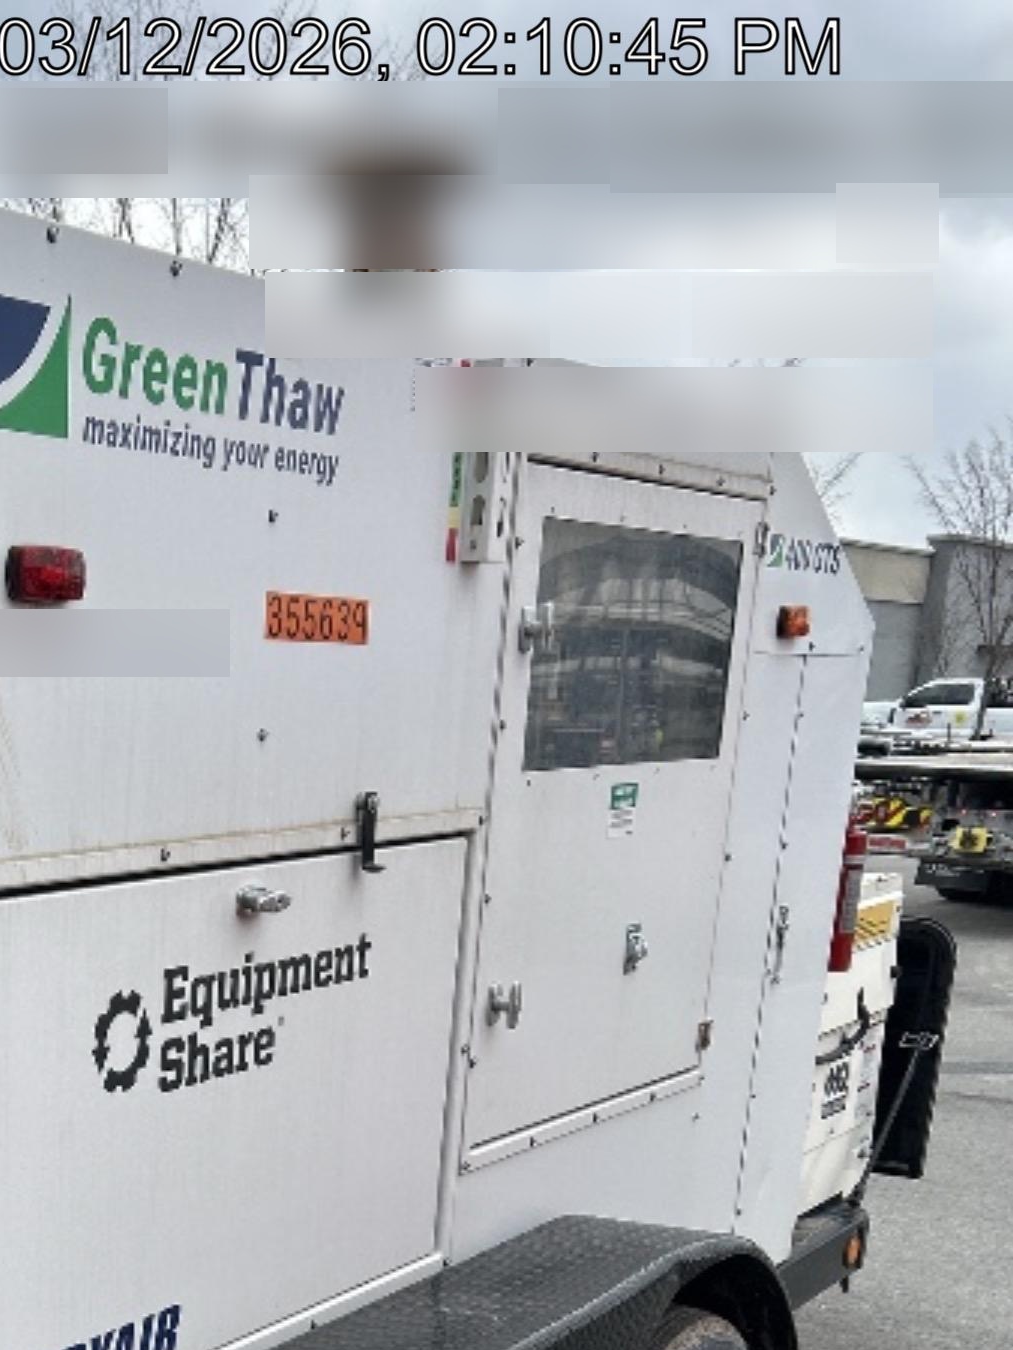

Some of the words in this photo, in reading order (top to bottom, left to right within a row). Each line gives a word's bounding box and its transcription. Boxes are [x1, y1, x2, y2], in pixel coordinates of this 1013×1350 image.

[82, 316, 345, 435] GreenThaw
[82, 414, 216, 469] maximizing
[222, 436, 270, 471] your
[274, 446, 340, 486] energy
[268, 595, 366, 644] 355639
[160, 932, 372, 1029] Equipment
[158, 1026, 276, 1092] Share
